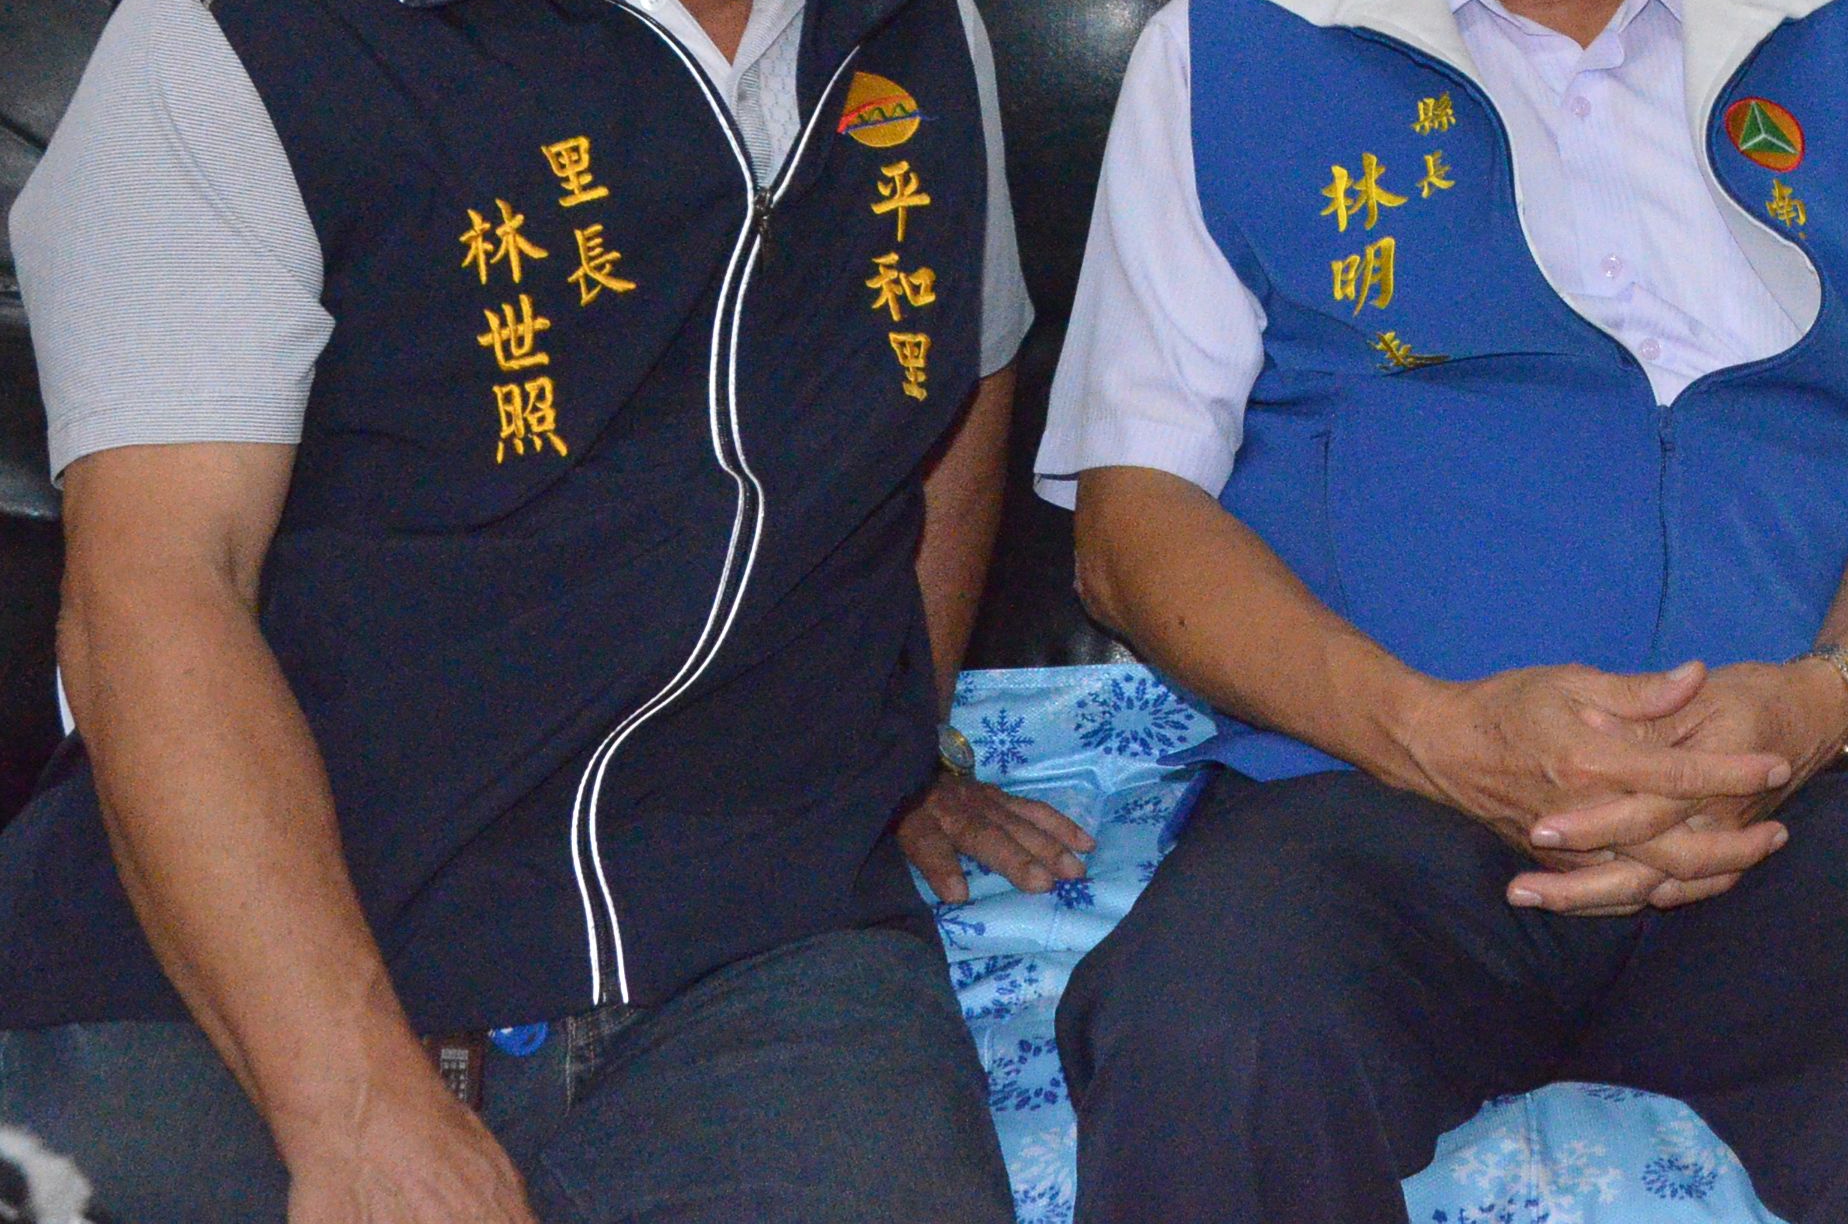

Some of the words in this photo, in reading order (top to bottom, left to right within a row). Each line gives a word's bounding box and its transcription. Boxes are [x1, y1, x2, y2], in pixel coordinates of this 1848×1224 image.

[541, 135, 638, 307] 里長
[1412, 92, 1457, 198] 縣長
[459, 198, 569, 465] 林世照
[864, 159, 938, 402] 平和里
